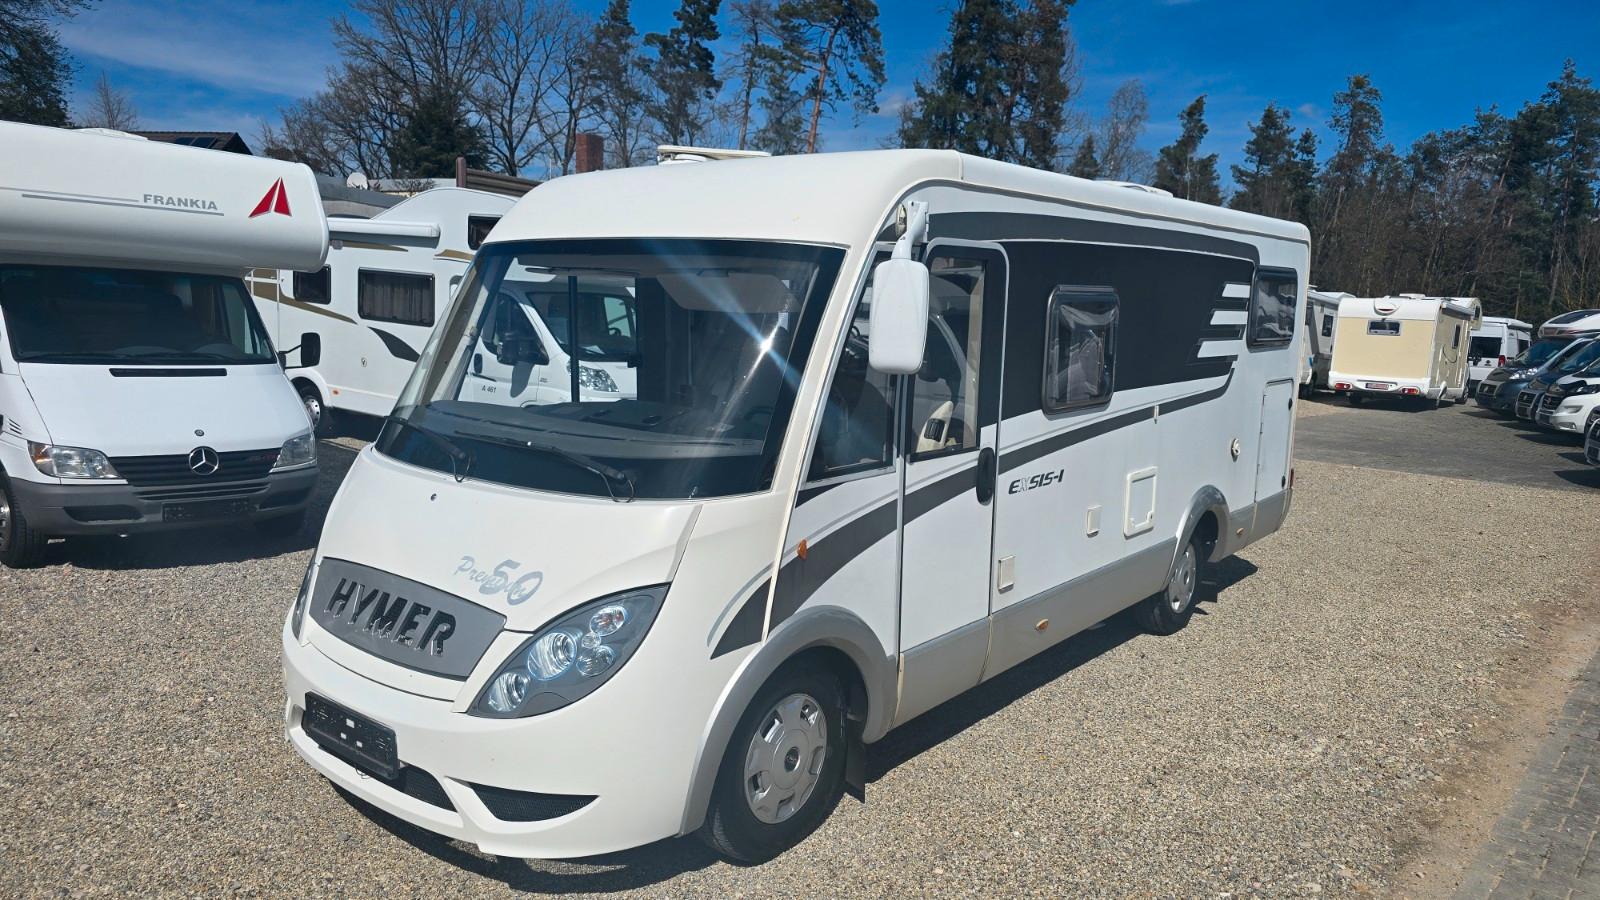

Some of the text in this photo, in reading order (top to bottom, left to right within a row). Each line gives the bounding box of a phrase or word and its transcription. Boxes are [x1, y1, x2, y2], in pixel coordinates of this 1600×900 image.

[143, 194, 218, 211] FRANKIA
[1008, 469, 1065, 495] EXSIS-I
[478, 559, 543, 606] 50
[324, 577, 457, 657] HYMER
